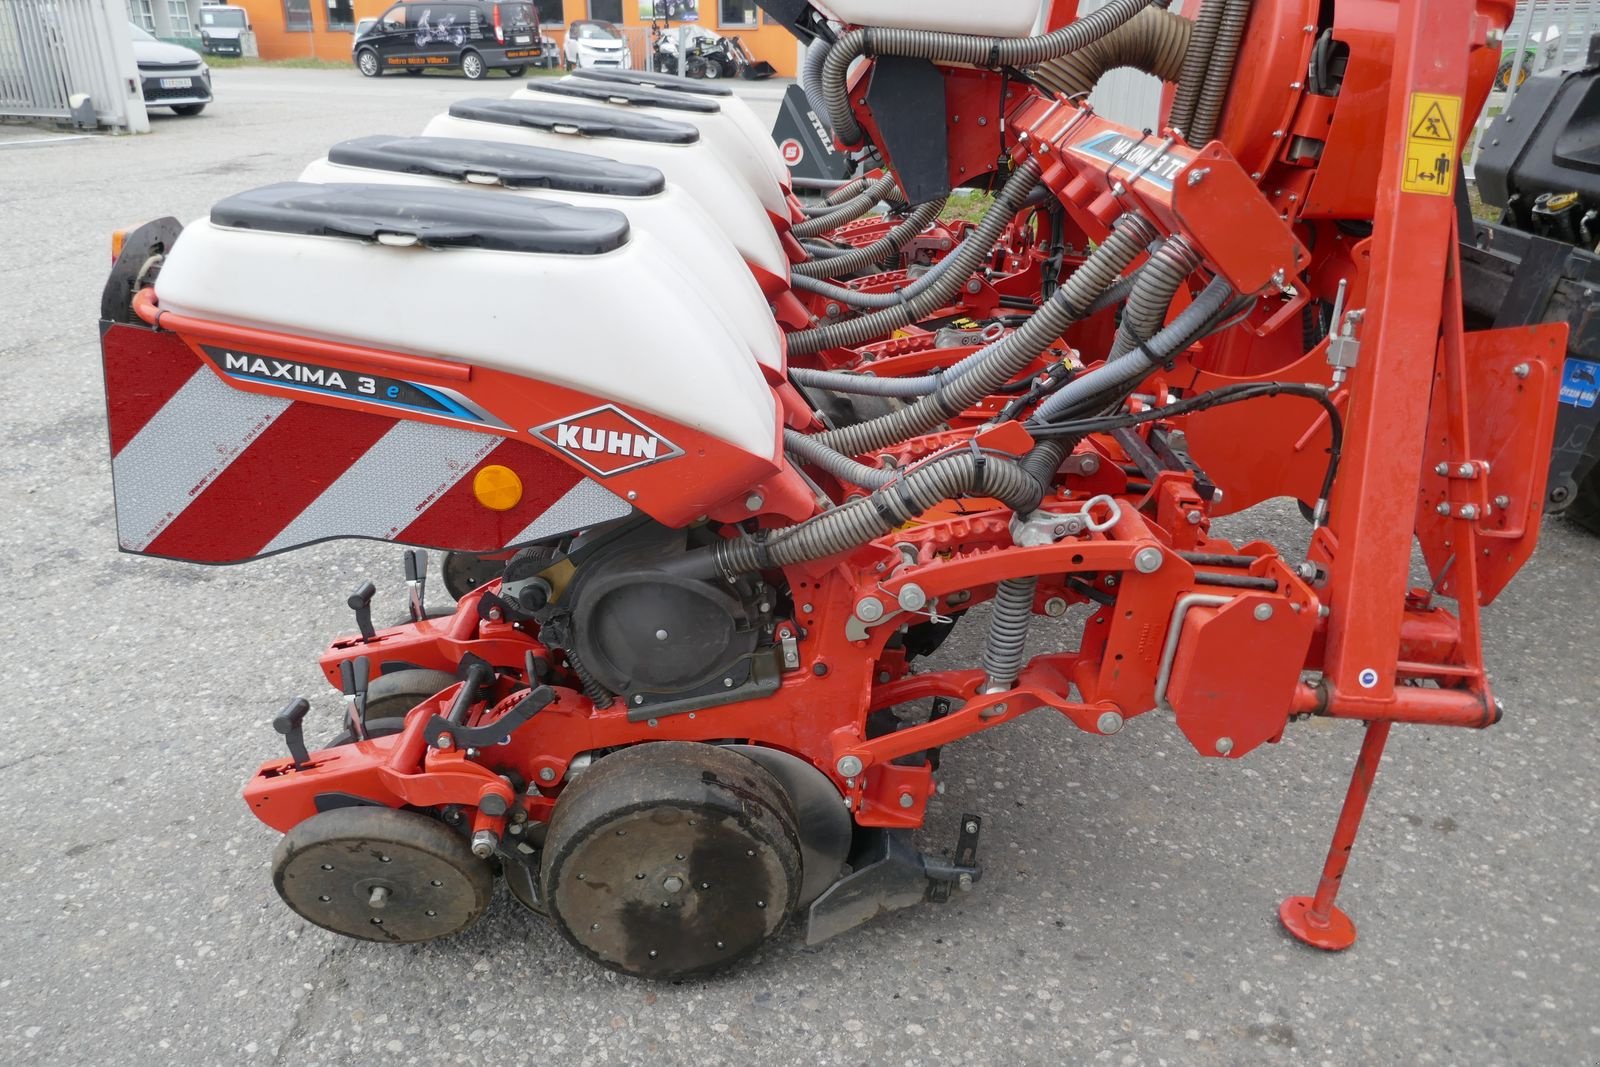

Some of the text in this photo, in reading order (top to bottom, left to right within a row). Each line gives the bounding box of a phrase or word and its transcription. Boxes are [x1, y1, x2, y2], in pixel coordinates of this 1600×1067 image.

[806, 110, 836, 155] STOLL
[1149, 154, 1170, 172] 3
[225, 352, 399, 398] MAXIMA 3 e
[557, 423, 658, 459] KUHN
